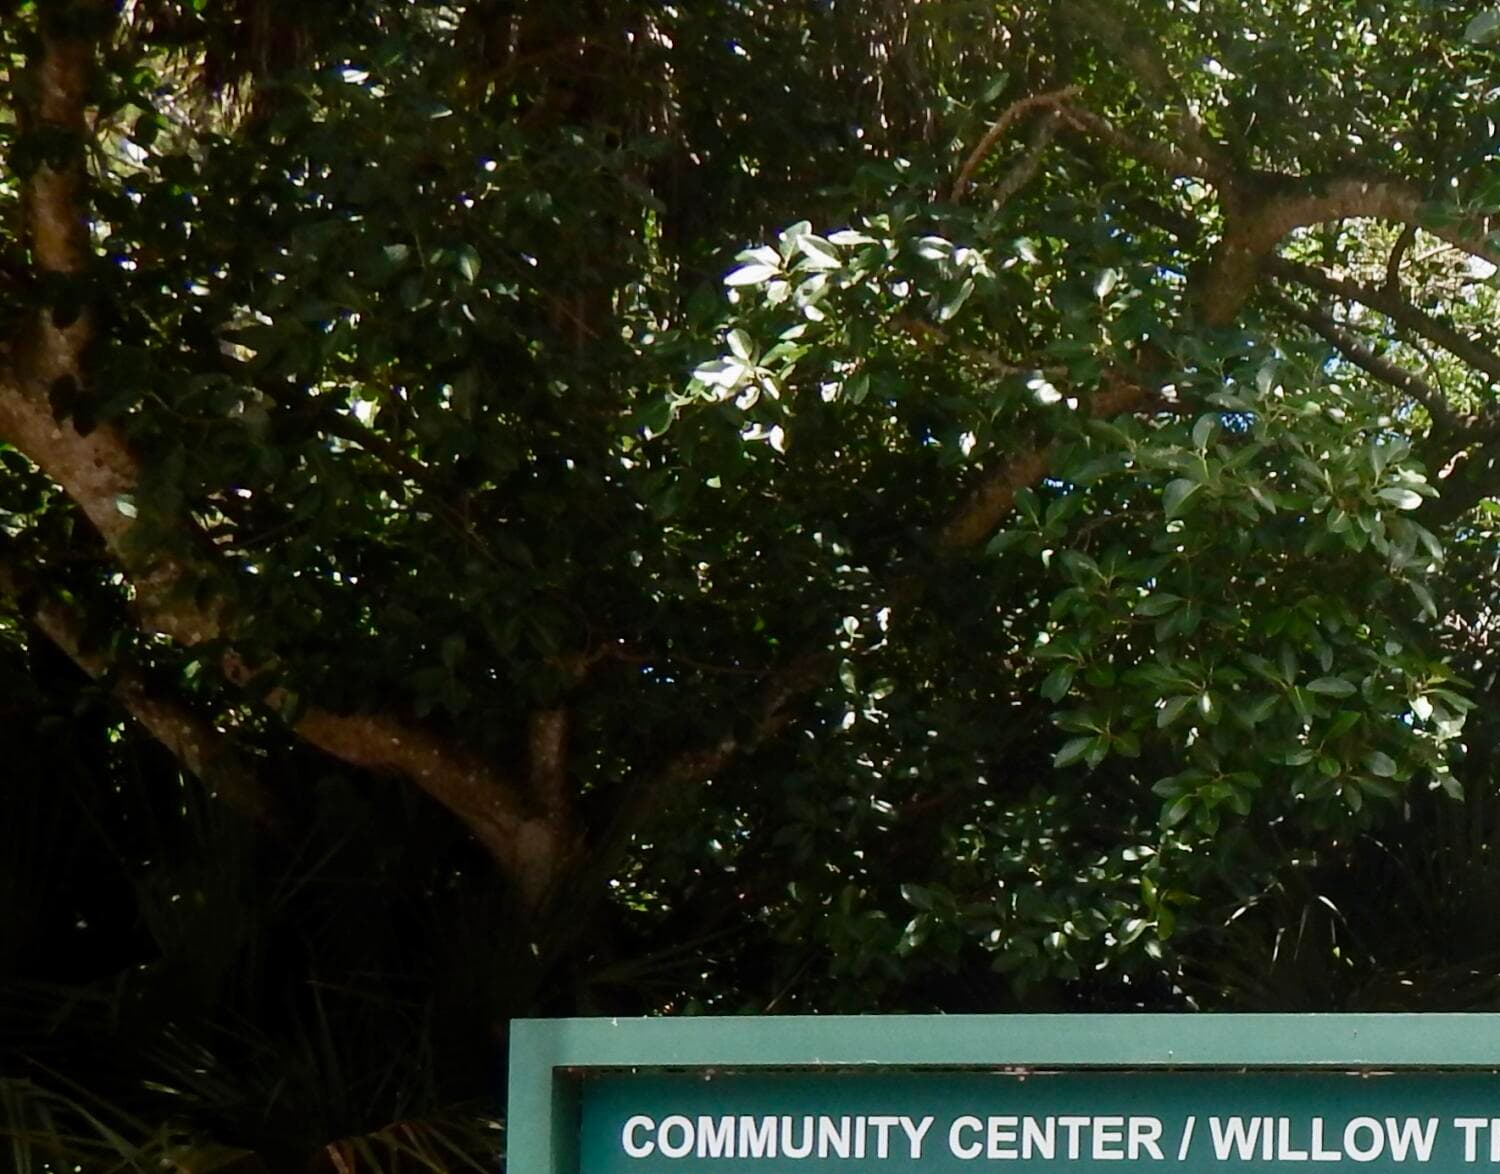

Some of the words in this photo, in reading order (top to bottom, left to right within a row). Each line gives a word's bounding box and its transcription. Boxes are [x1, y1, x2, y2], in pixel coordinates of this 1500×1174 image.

[621, 1115, 934, 1159] COMMUNITY
[948, 1115, 1164, 1161] CENTER
[1177, 1116, 1195, 1160] /
[1209, 1117, 1439, 1162] WILLOW
